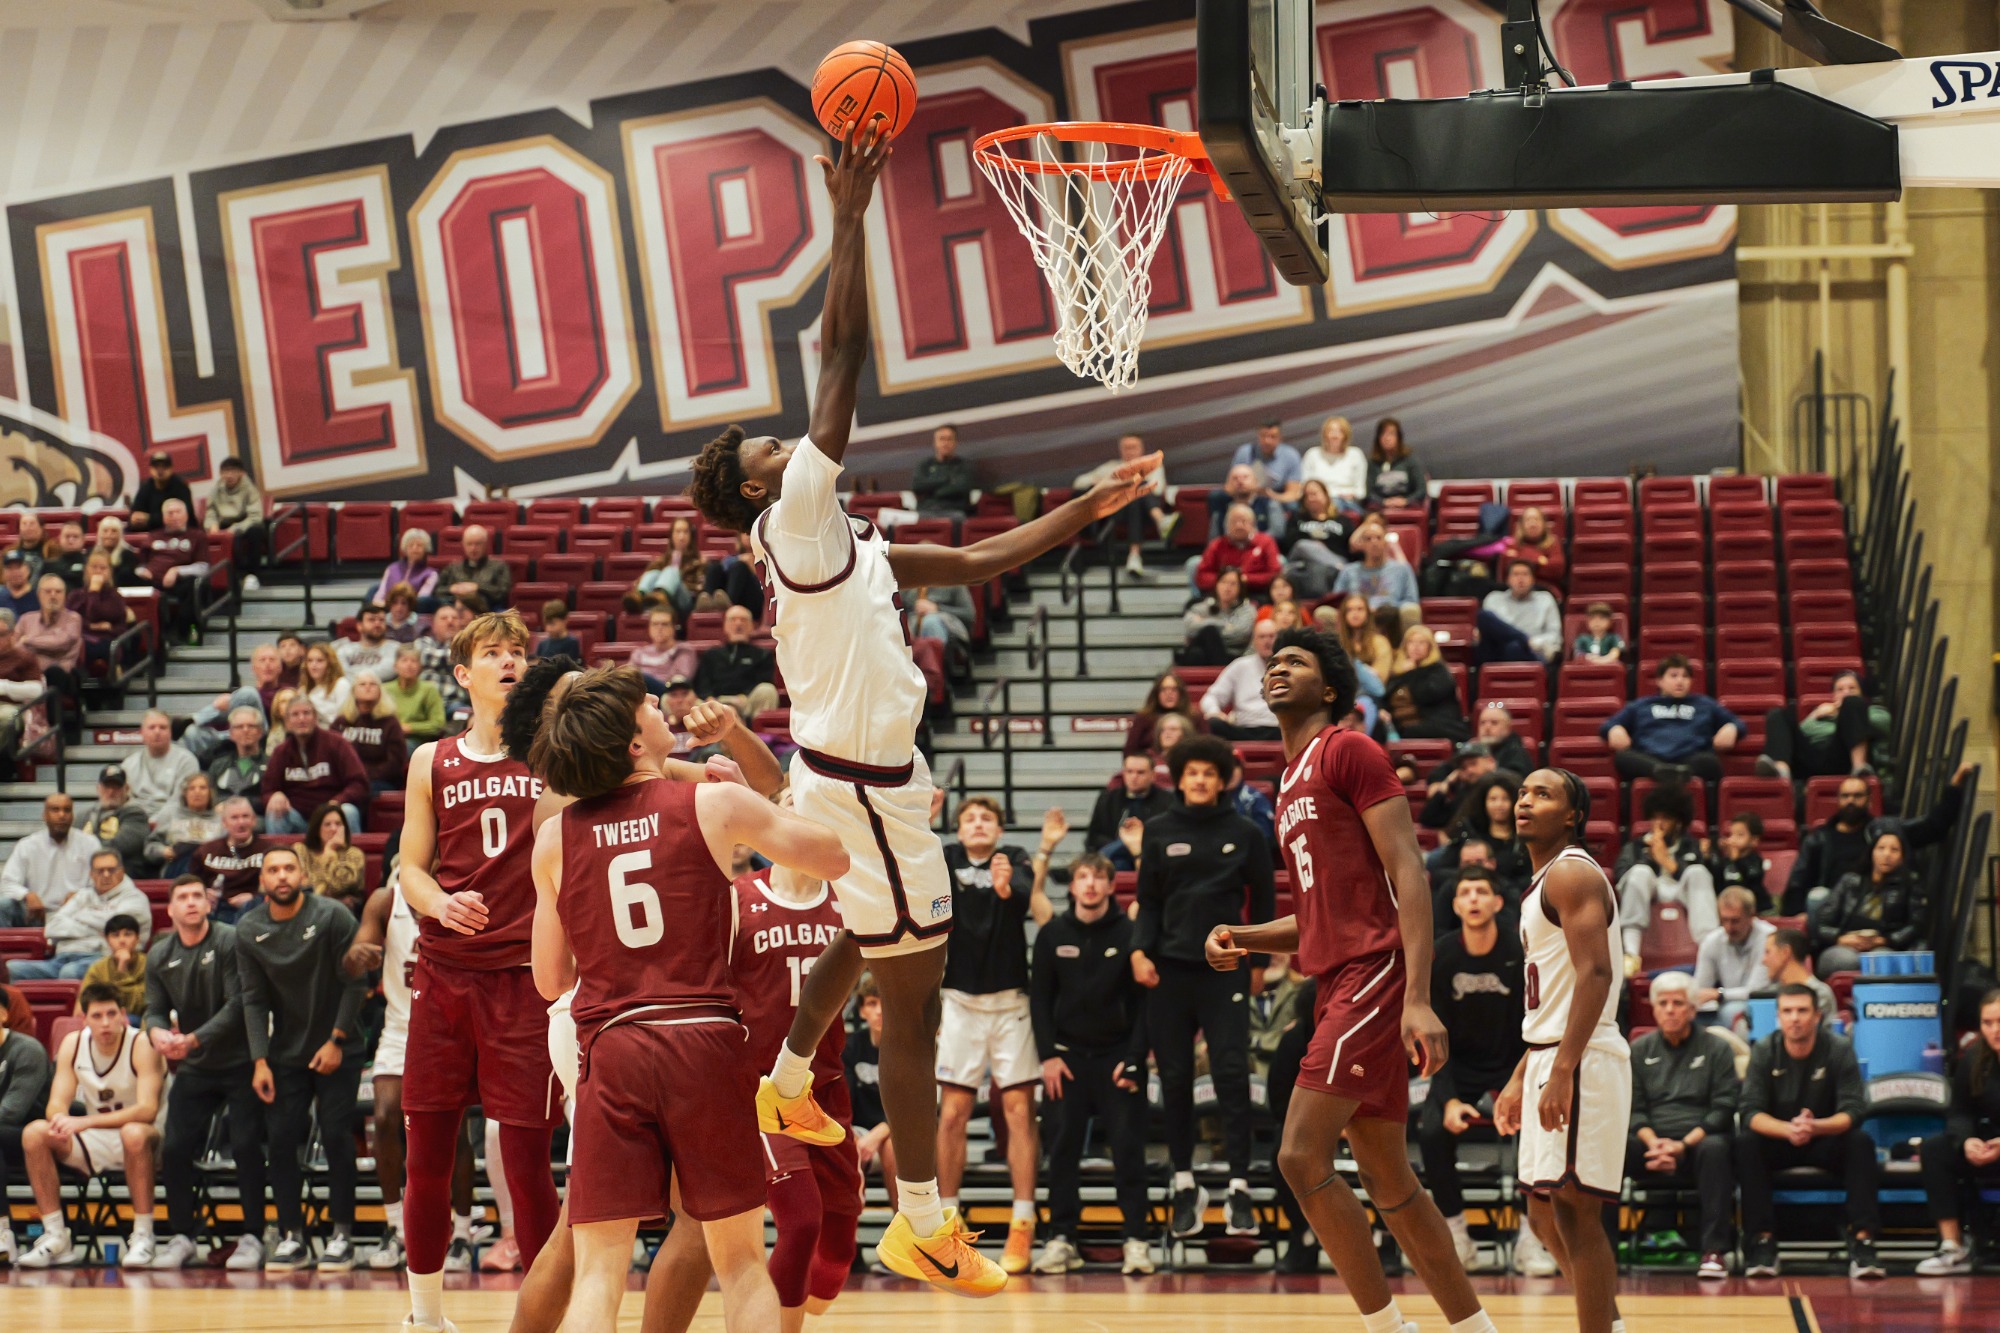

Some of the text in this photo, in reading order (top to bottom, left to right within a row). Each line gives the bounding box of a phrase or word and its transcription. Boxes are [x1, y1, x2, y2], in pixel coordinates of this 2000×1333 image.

[442, 775, 543, 809] COLGATE
[480, 807, 507, 858] 0
[592, 812, 659, 848] TWEEDY
[1288, 832, 1315, 893] 15
[607, 849, 665, 949] 6
[753, 923, 844, 955] COLGAT
[785, 956, 820, 1007] 1
